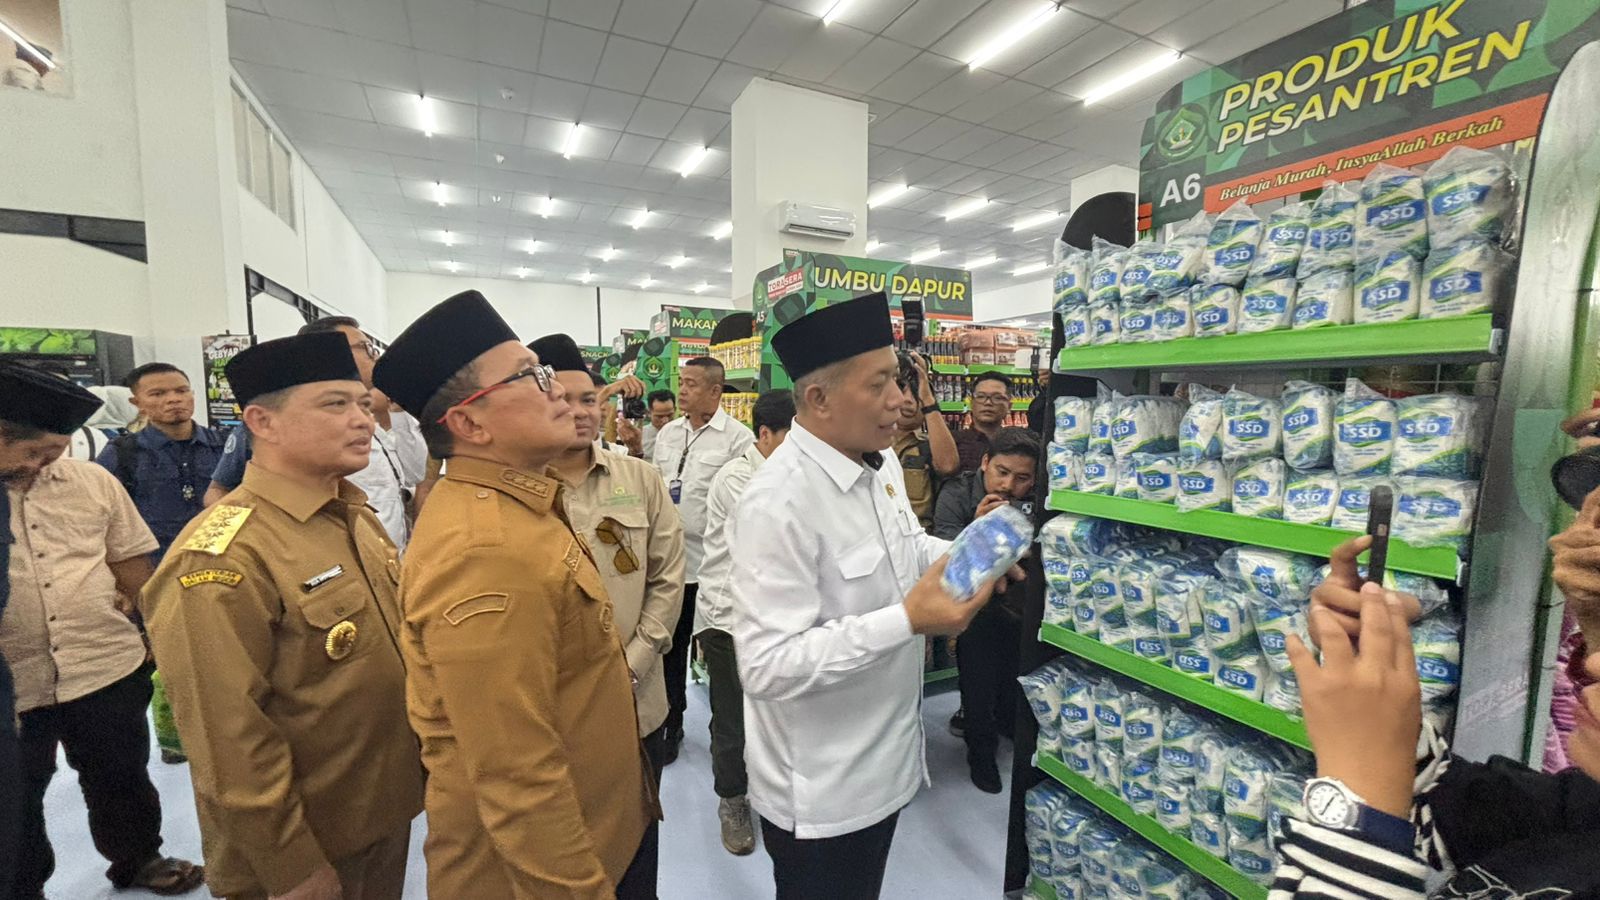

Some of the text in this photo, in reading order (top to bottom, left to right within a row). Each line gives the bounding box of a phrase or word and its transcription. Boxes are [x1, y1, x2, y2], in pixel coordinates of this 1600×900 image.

[1218, 0, 1466, 121] PRODUK
[1216, 20, 1532, 154] PESANTREN
[1220, 116, 1504, 202] Belanja Murah, InsyaAllah Berkah
[1159, 172, 1201, 208] A6
[1443, 190, 1480, 207] SSD
[1379, 206, 1416, 221] SSD
[1275, 228, 1305, 239] SSD
[1321, 231, 1351, 242] SSD
[1224, 250, 1250, 262] SSD
[891, 277, 966, 301] DAPUR
[1435, 277, 1471, 293] SSD
[1366, 286, 1402, 300] SSD
[1250, 298, 1277, 309] SSD
[1125, 319, 1145, 328] SSD
[580, 350, 609, 358] SNACK
[1288, 413, 1309, 427] SSD
[1236, 423, 1263, 434] SSD
[1349, 426, 1382, 438] SSD
[1405, 422, 1440, 434] SSD
[1143, 477, 1164, 485] SSD
[1182, 479, 1206, 489] SSD
[1238, 482, 1261, 493] SSD
[1295, 492, 1322, 503] SSD
[1139, 641, 1161, 651] SSD
[1178, 654, 1201, 667] SSD
[1223, 671, 1248, 686] SSD
